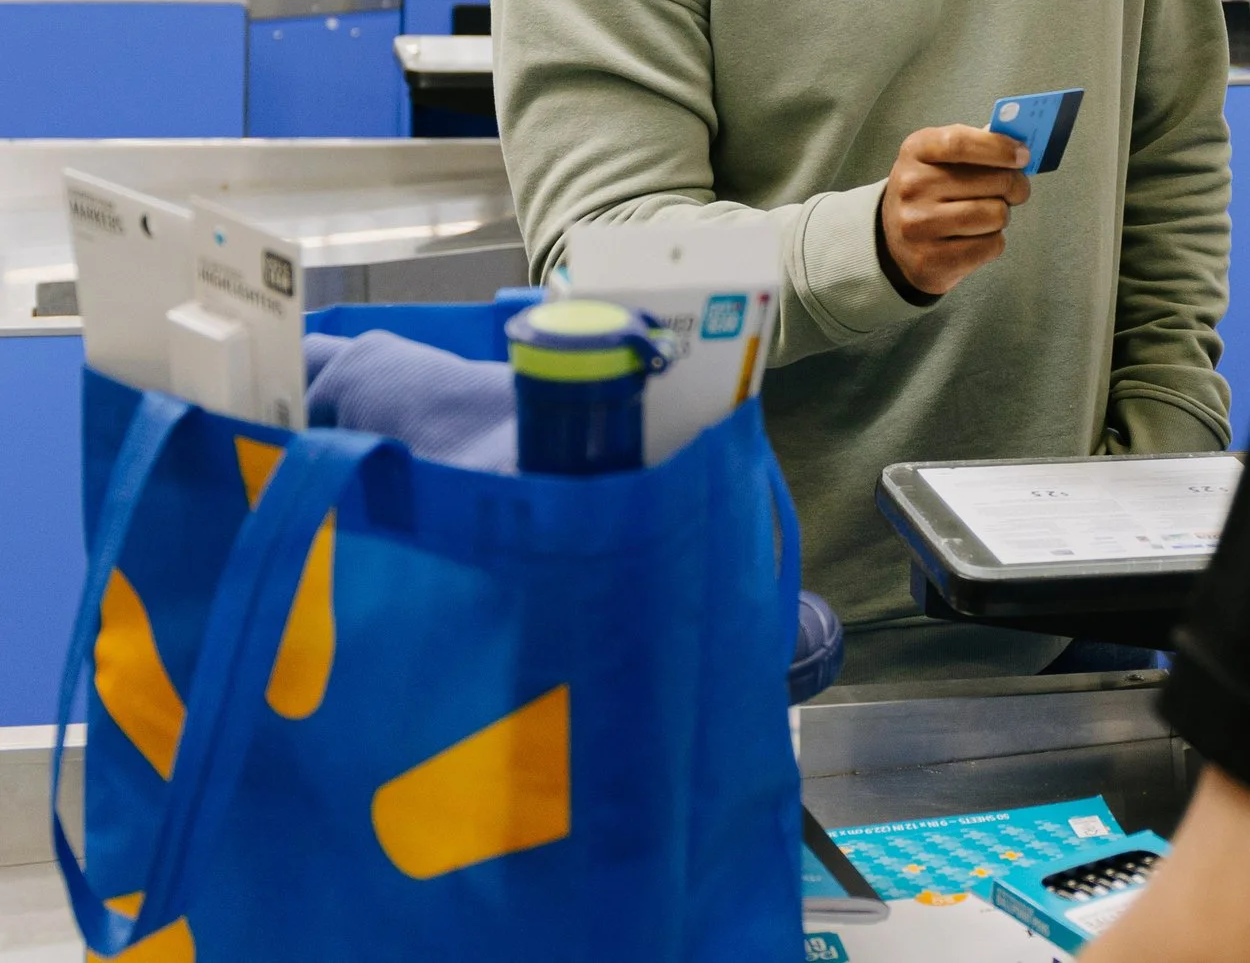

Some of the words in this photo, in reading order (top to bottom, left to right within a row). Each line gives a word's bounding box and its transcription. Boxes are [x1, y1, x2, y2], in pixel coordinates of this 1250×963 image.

[69, 199, 124, 234] MARKERS
[200, 268, 284, 316] HIGHLIGHTERS
[958, 815, 996, 825] SHEETS
[996, 813, 1010, 821] 50
[892, 824, 905, 832] IN
[905, 823, 918, 831] 12
[847, 828, 864, 836] cm
